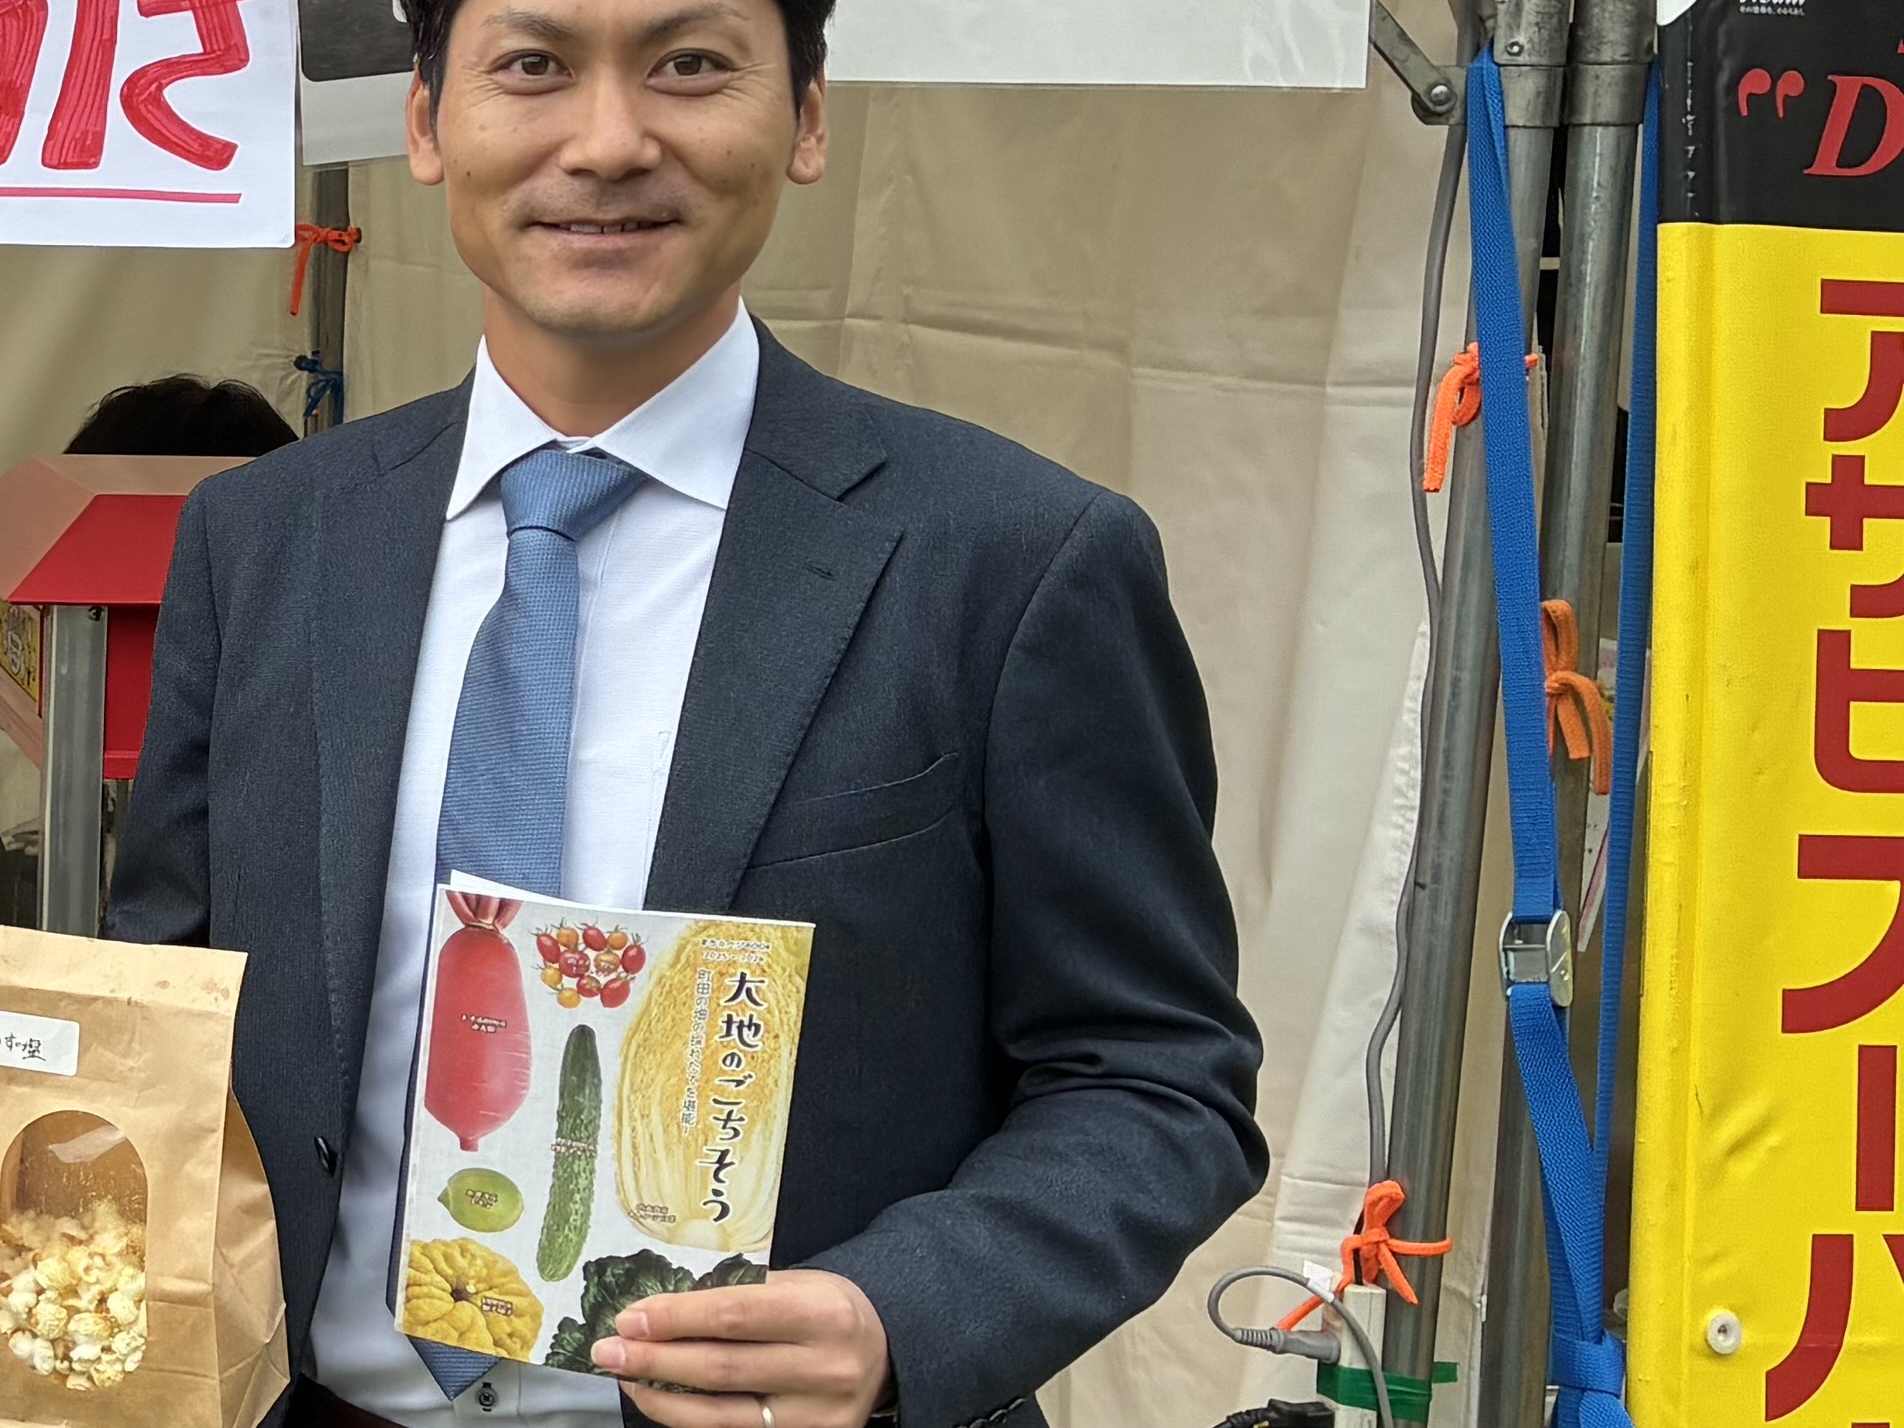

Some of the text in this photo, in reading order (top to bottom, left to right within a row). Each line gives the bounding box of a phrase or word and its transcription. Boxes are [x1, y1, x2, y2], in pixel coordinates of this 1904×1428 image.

[697, 971, 767, 1223] 大地のごちそう
